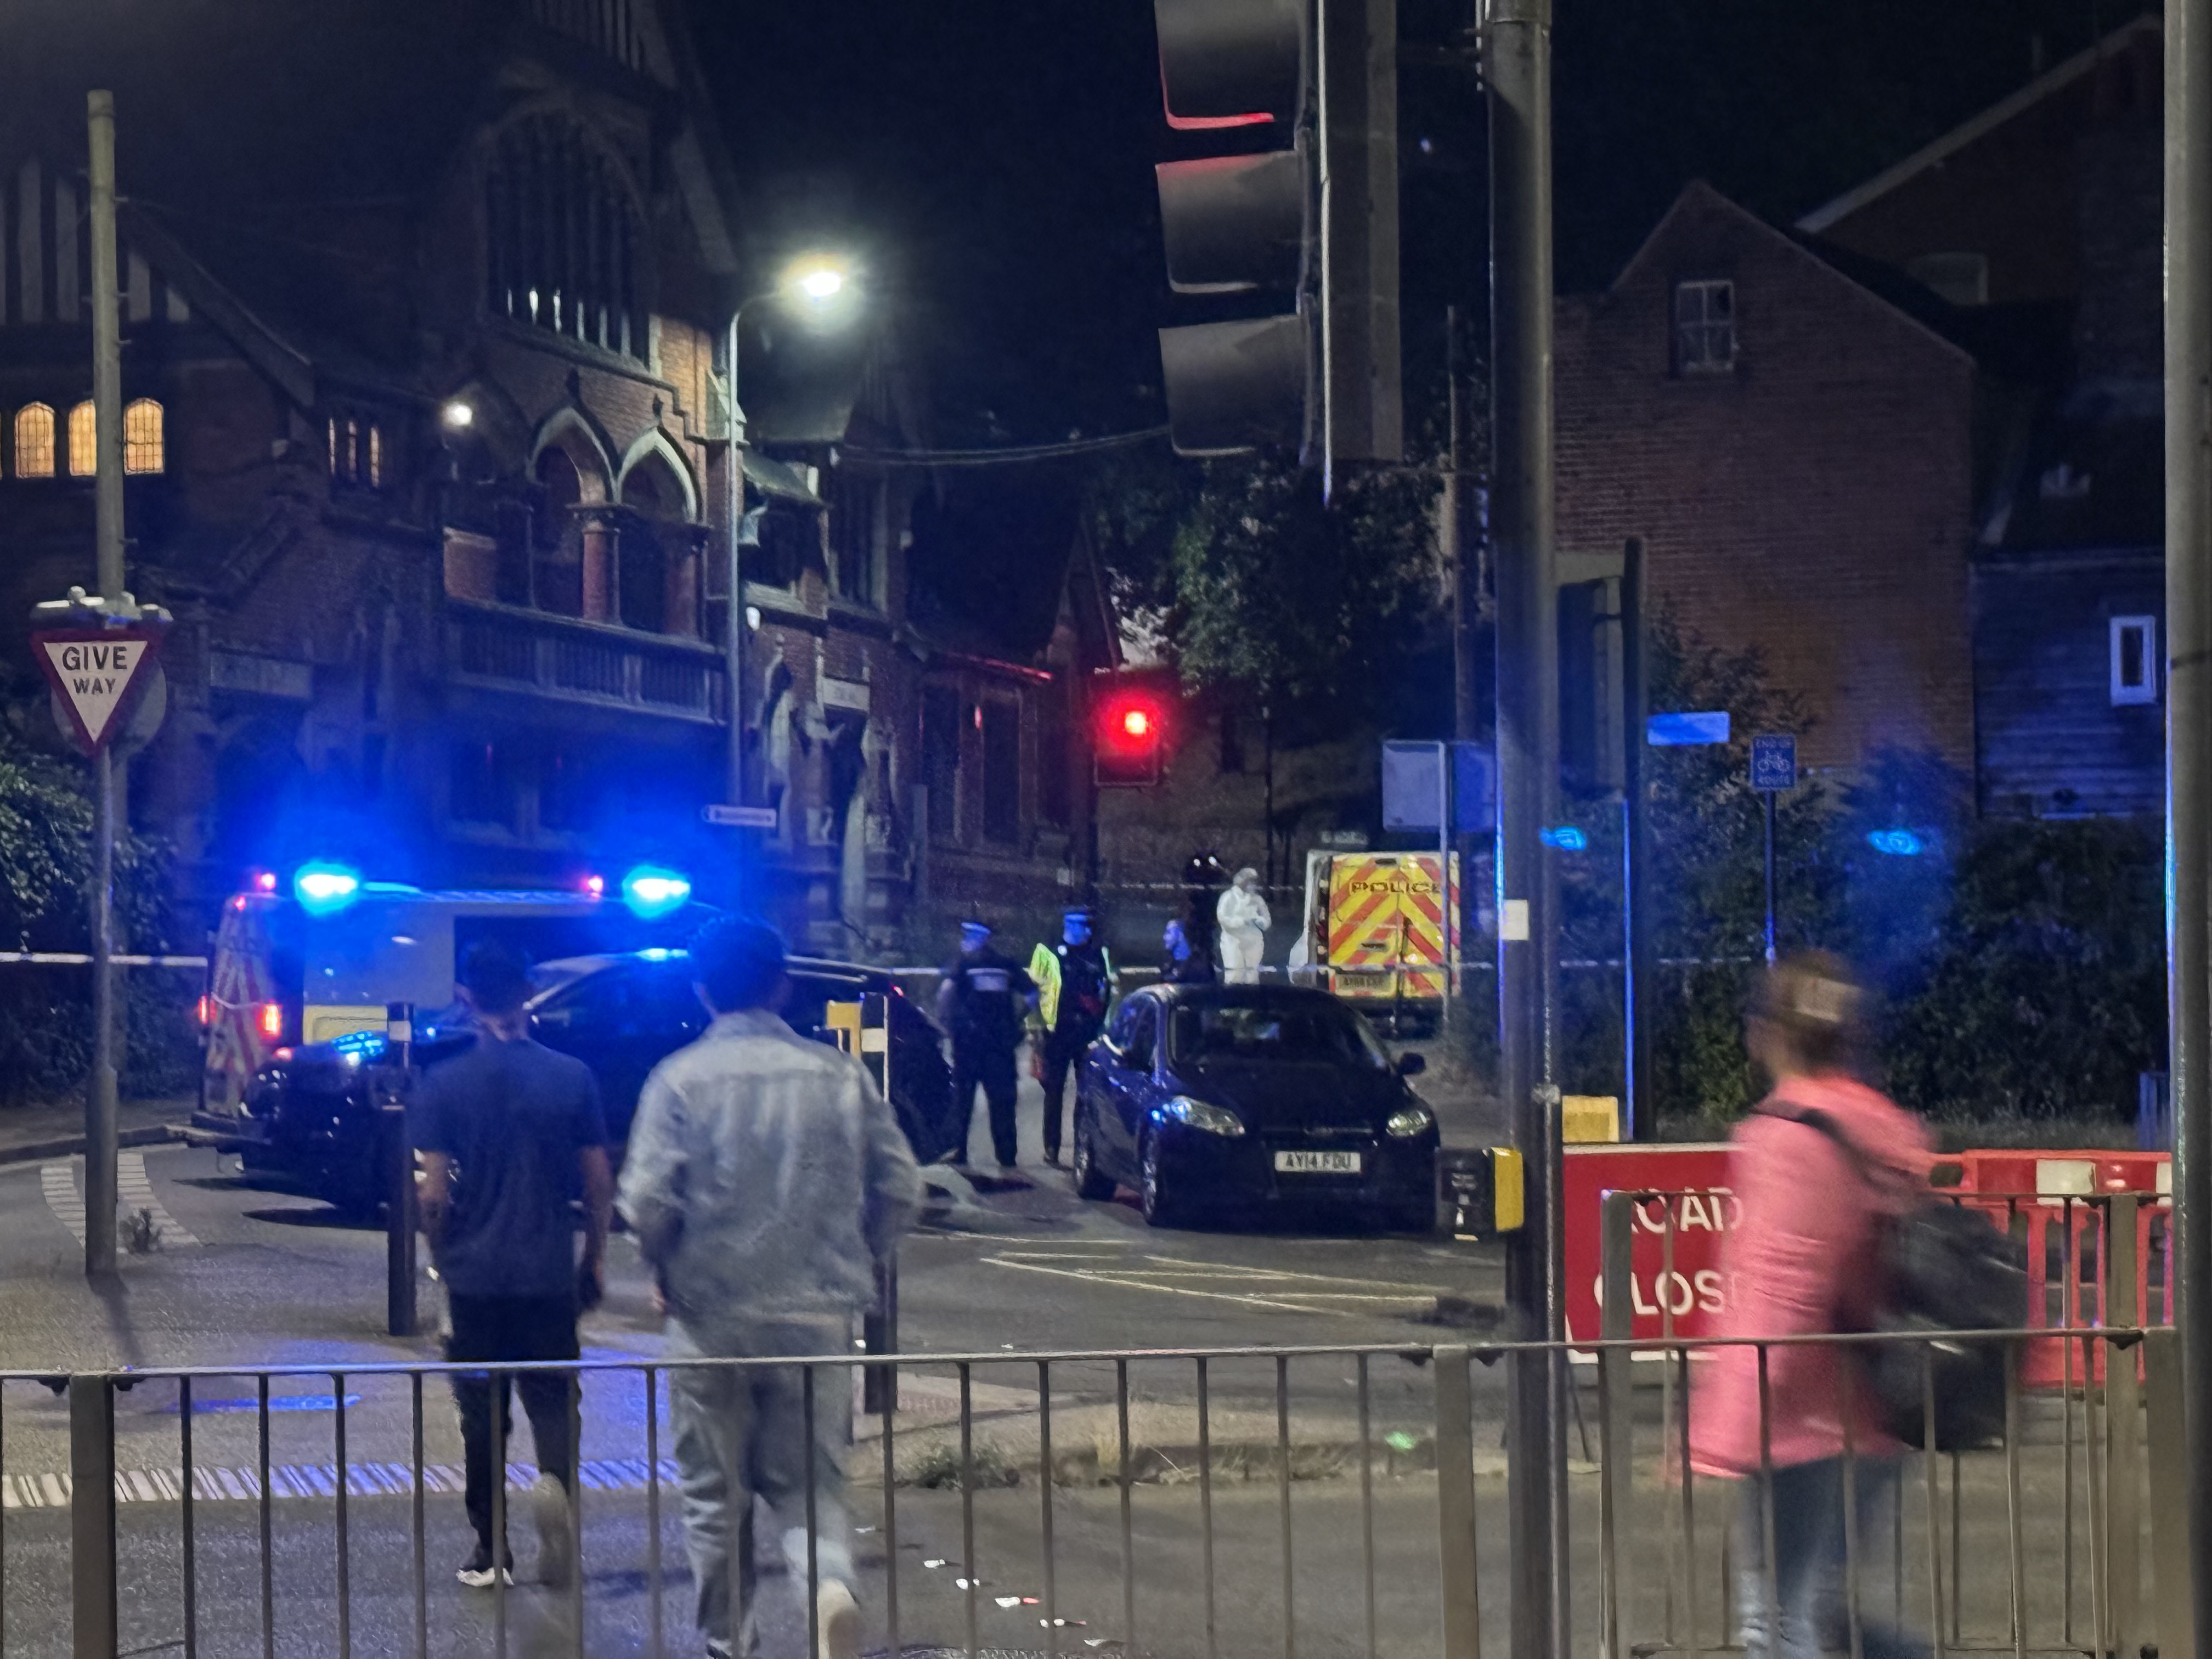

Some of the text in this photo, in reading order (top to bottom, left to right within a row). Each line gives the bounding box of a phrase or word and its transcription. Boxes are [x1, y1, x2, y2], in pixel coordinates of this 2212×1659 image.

[62, 646, 127, 670] GIVE
[73, 678, 116, 695] WAY
[1631, 1187, 1744, 1234] OAD
[1594, 1269, 1734, 1315] LOS
